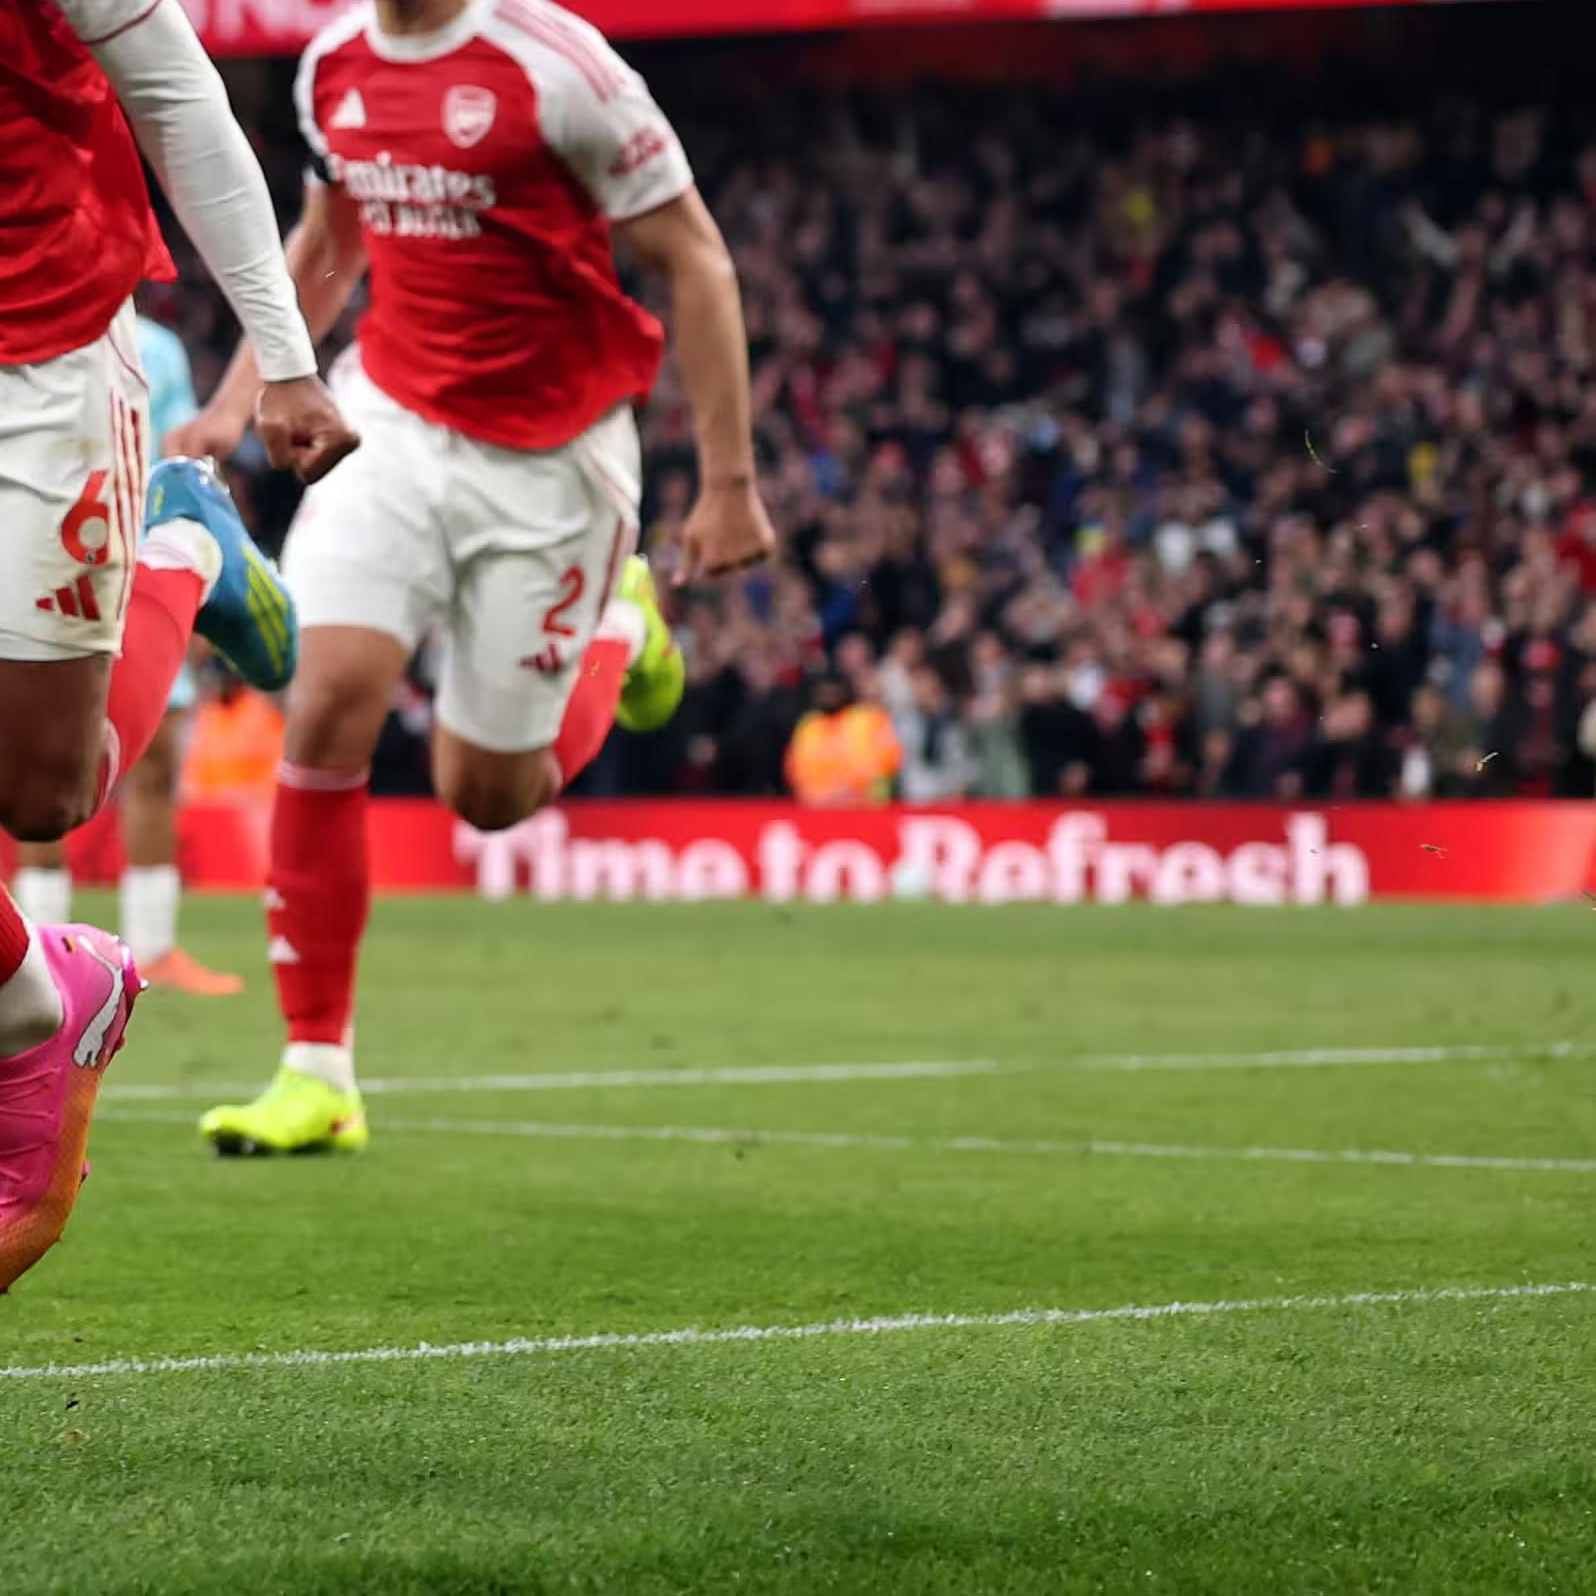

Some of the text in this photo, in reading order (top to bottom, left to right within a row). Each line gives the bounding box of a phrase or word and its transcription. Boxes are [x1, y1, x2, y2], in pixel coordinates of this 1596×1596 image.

[60, 468, 110, 567] 6
[541, 564, 585, 637] 2
[452, 808, 1371, 905] Time to Refresh
